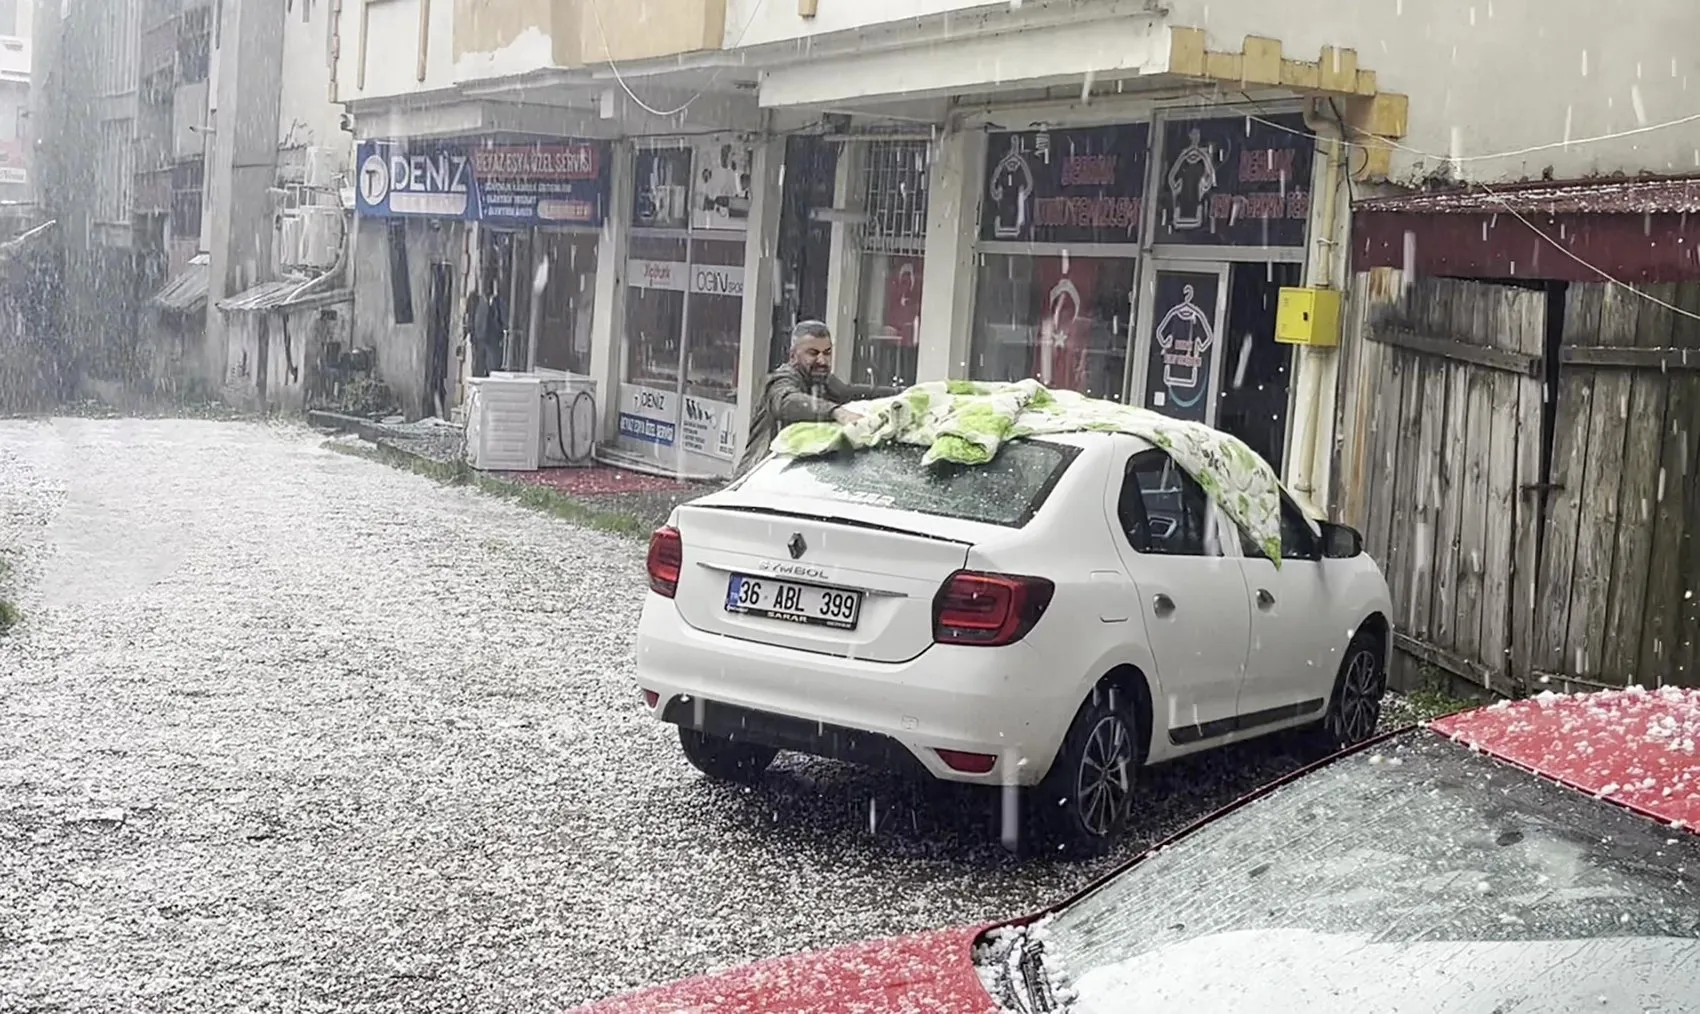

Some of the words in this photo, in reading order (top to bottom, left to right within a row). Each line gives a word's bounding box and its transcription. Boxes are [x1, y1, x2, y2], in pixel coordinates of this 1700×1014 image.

[391, 150, 468, 192] DENİZ
[759, 561, 829, 580] SYMBOL
[740, 580, 762, 606] 36
[773, 585, 805, 612] ABL
[820, 592, 855, 619] 399
